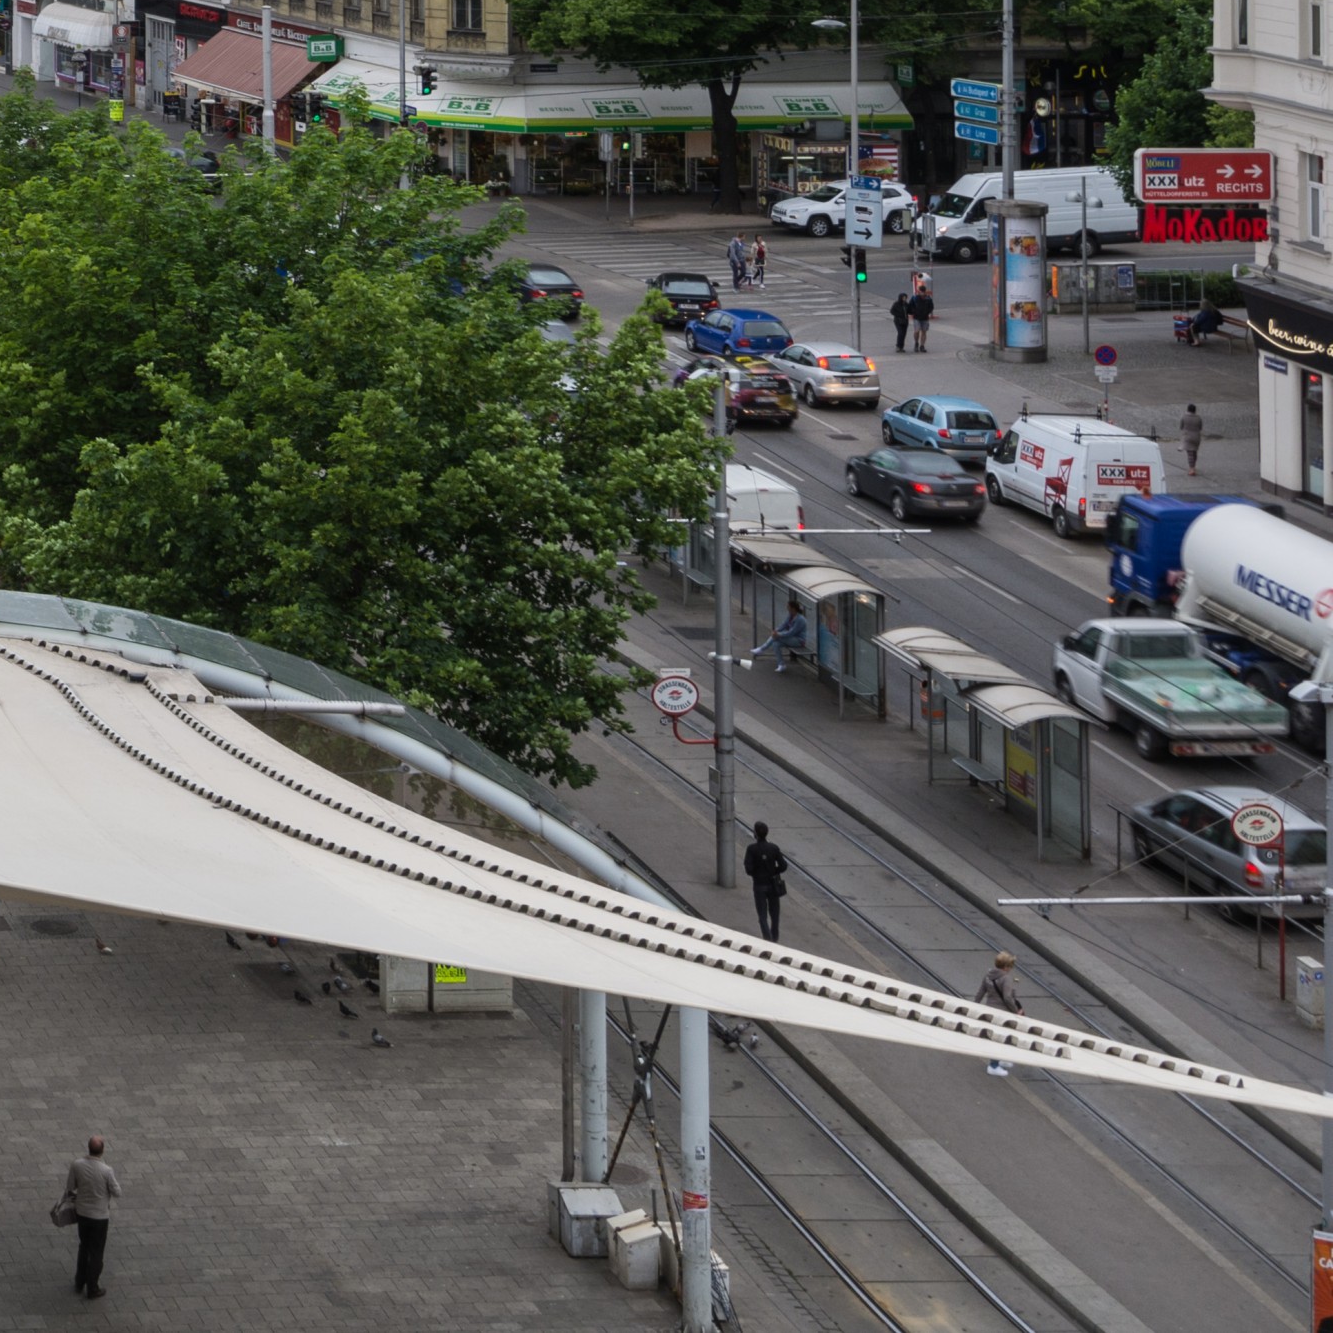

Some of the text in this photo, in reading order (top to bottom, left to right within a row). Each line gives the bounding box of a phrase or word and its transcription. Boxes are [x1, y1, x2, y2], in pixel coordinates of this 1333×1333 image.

[447, 100, 490, 111] B&B
[595, 105, 640, 114] B&B
[785, 102, 830, 112] B&B
[1216, 182, 1264, 193] RECHTS
[1293, 335, 1326, 354] wine
[1235, 562, 1312, 623] MESSER
[1237, 809, 1278, 824] STRASSENBAHN
[1239, 830, 1276, 842] HALTESTELLE
[1266, 851, 1273, 859] 6
